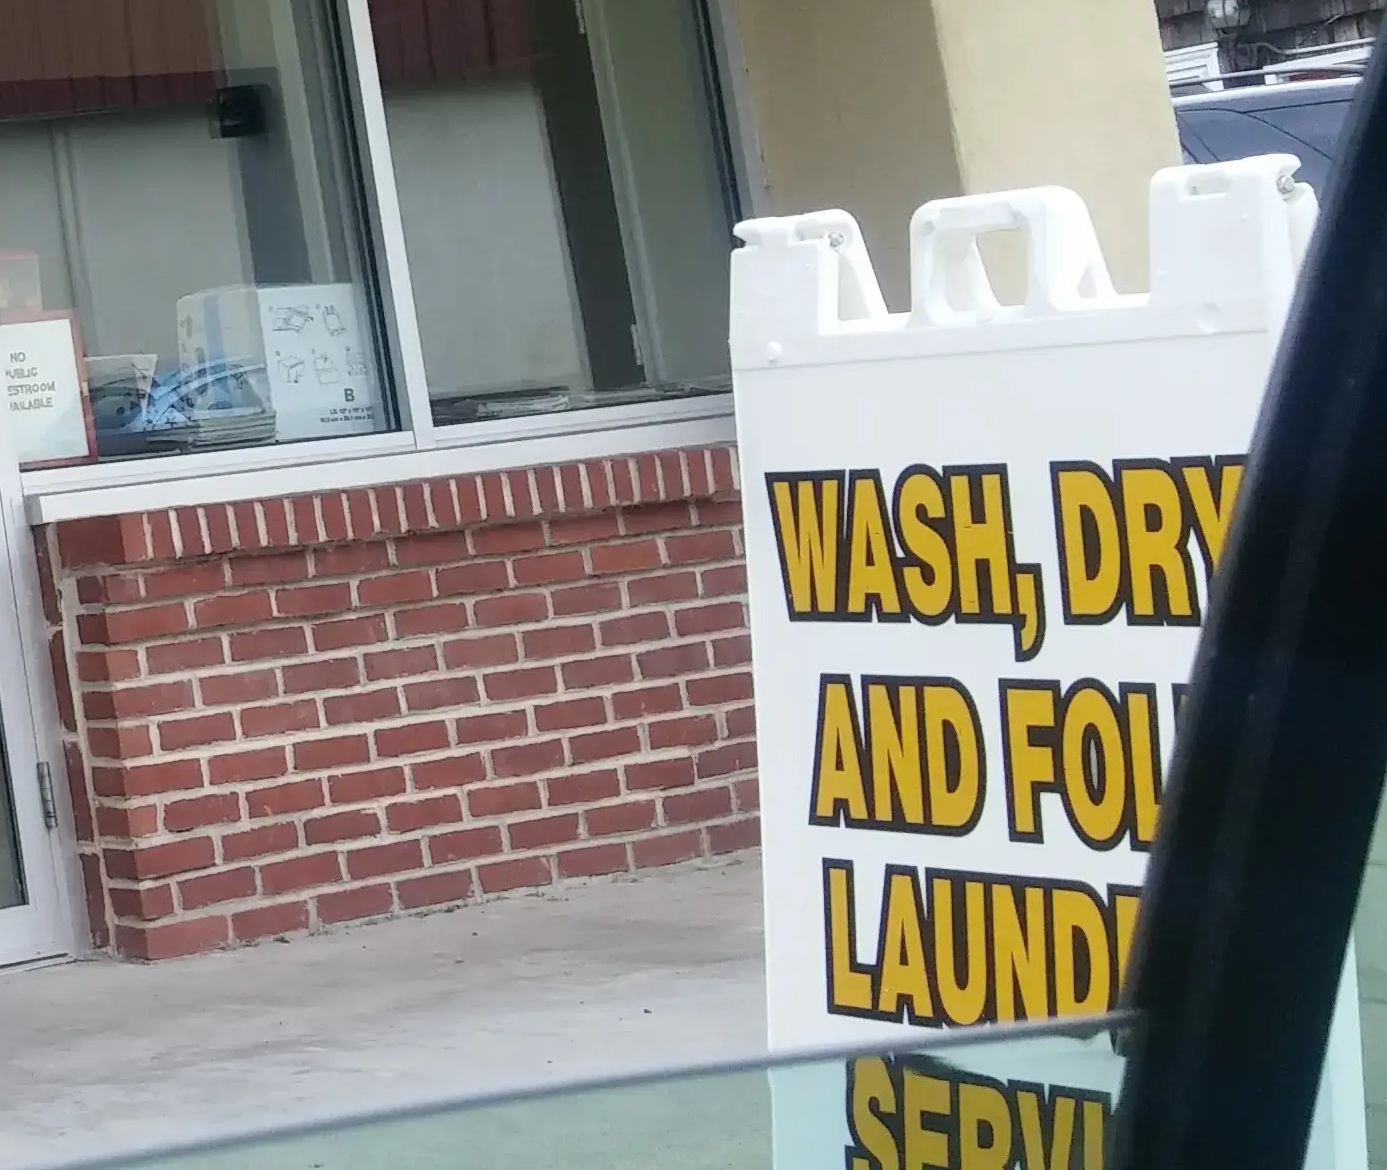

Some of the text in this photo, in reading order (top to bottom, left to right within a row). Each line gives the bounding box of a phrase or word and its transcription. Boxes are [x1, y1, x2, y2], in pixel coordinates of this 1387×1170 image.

[7, 381, 56, 396] ESTROOM
[10, 352, 27, 363] NO
[344, 388, 355, 403] B
[765, 463, 1047, 662] WASH,
[808, 673, 1193, 853] AND FOL
[822, 857, 1144, 1032] LAUND
